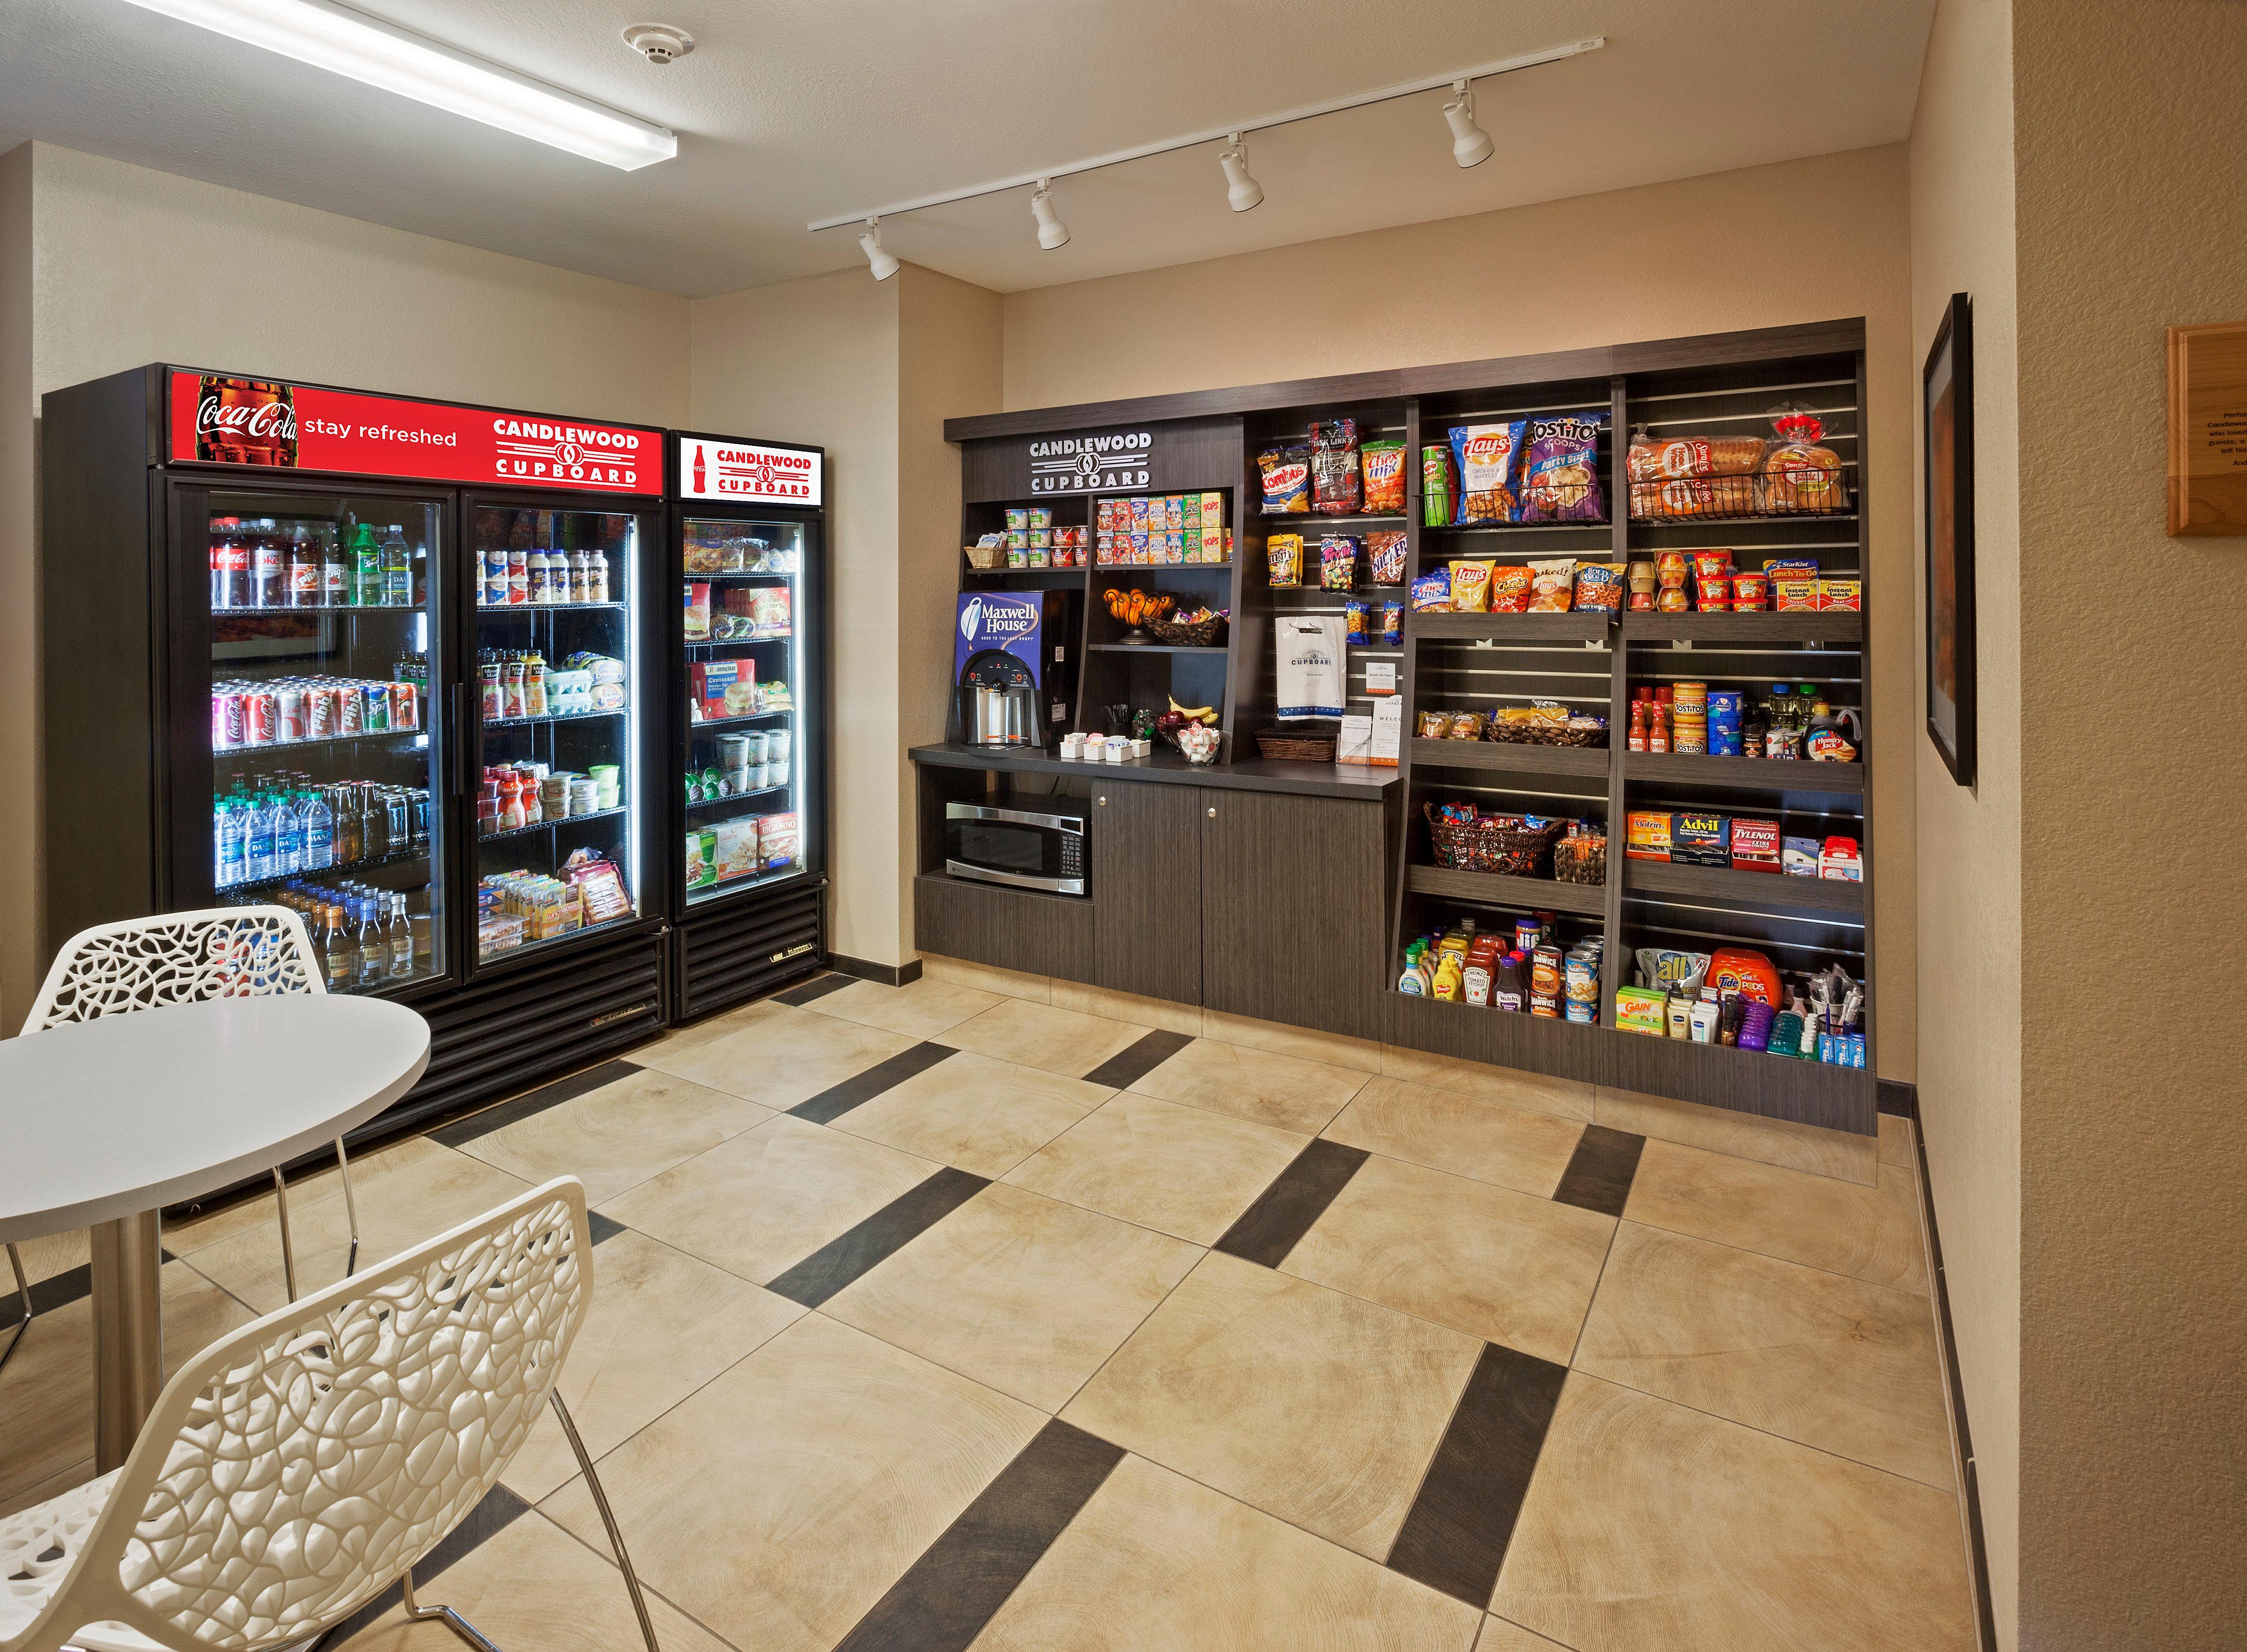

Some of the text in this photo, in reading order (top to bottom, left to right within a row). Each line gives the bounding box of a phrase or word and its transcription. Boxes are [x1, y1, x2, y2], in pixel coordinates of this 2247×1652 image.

[196, 396, 298, 440] Coca-Cola
[305, 419, 456, 447] stay refreshed
[493, 419, 639, 449] CANDLEWOOD
[1030, 433, 1152, 457] CANDLEWOOD
[1331, 437, 1352, 445] LINK'S
[1467, 436, 1510, 456] Lay's
[1545, 438, 1584, 451] SCOOPS!
[717, 450, 811, 469] CANDLEWOOD
[1369, 452, 1399, 468] Chex
[1541, 450, 1590, 471] Party Size!
[1696, 443, 1709, 471] Sara Lee
[496, 459, 637, 484] CUPBOARD
[1370, 461, 1396, 478] mix
[1032, 471, 1149, 490] CUPBOARD
[1263, 467, 1304, 489] Combos
[719, 479, 809, 495] CUPBOARD
[1185, 508, 1198, 517] JACKS
[1203, 502, 1218, 512] POPS
[1186, 542, 1199, 552] JACKS
[1204, 537, 1219, 547] POPS
[684, 545, 700, 557] Eggo
[1456, 568, 1486, 582] Lay's
[1585, 573, 1609, 582] GOLD
[1588, 567, 1609, 576] ROLD
[1419, 582, 1445, 593] Chex
[1496, 579, 1528, 593] Cheetos
[1421, 590, 1441, 598] mix
[981, 604, 1034, 618] Maxwell
[986, 619, 1028, 633] House
[312, 696, 330, 731] Pibb
[343, 693, 360, 728] Pibb
[1676, 704, 1703, 712] TOSTITOS
[228, 699, 241, 738] Coca-Cola
[261, 696, 275, 737] Coca-Cola
[1677, 744, 1703, 752] TOSTITOS
[1634, 819, 1662, 828] Motrin
[1681, 819, 1718, 831] Advil
[1735, 829, 1776, 840] TYLENOL
[547, 903, 578, 920] Lunchables
[1518, 933, 1540, 947] Jif
[1658, 956, 1688, 980] all
[1719, 977, 1738, 988] Tide
[1742, 981, 1764, 991] PODS
[1625, 1002, 1651, 1012] GAIN
